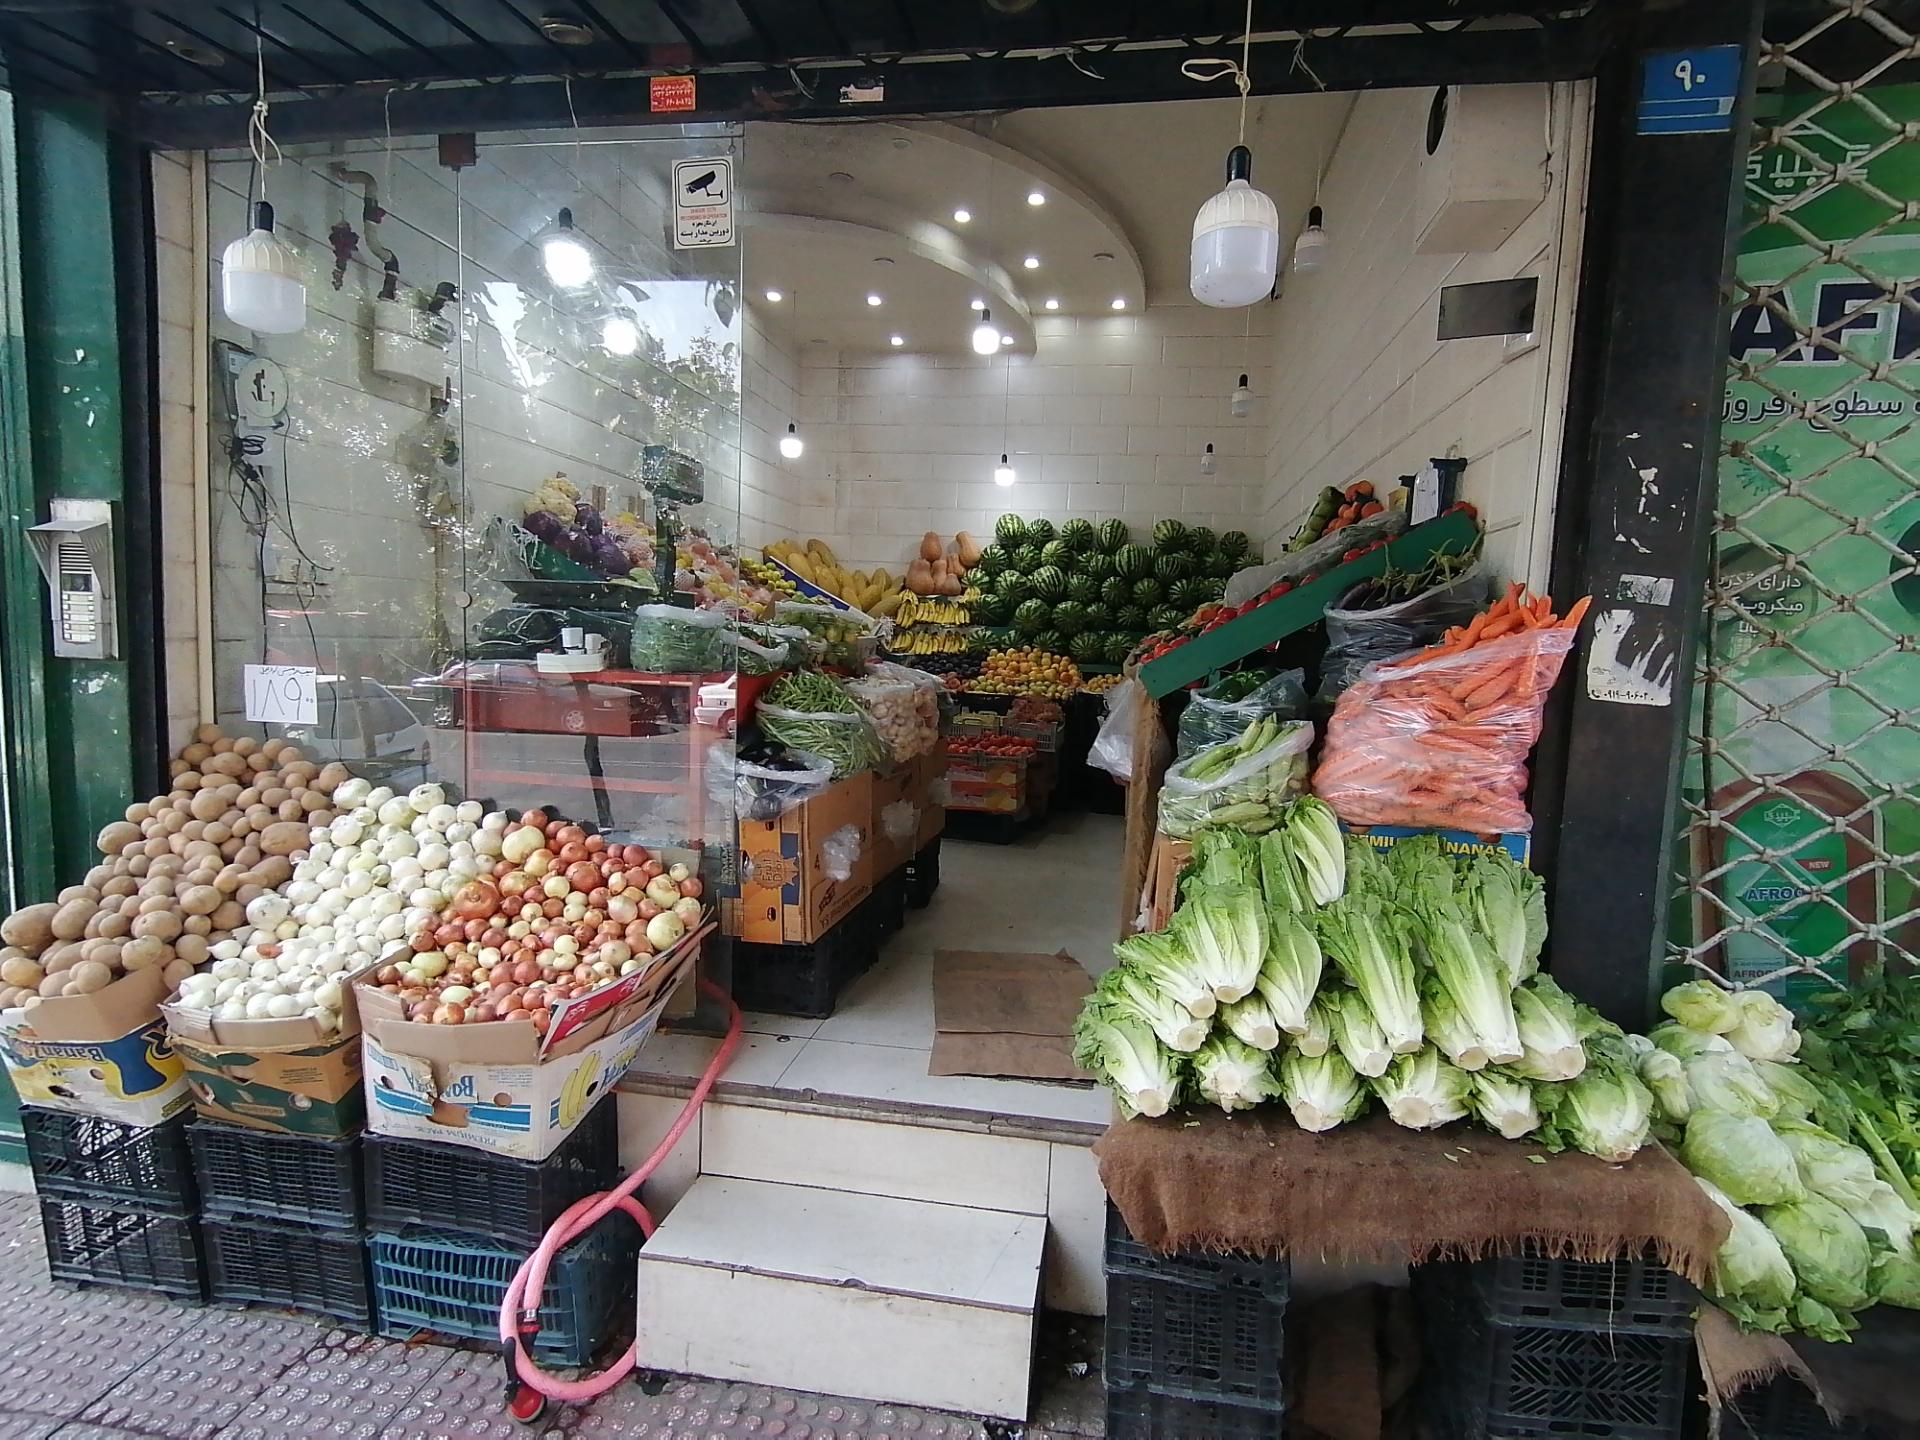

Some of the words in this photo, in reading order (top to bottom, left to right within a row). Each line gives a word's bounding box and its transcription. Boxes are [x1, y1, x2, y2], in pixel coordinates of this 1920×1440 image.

[1675, 59, 1706, 92] ۹۰
[1757, 573, 1802, 592] دارای
[1808, 861, 1830, 869] NEW
[1746, 886, 1805, 901] AFROO
